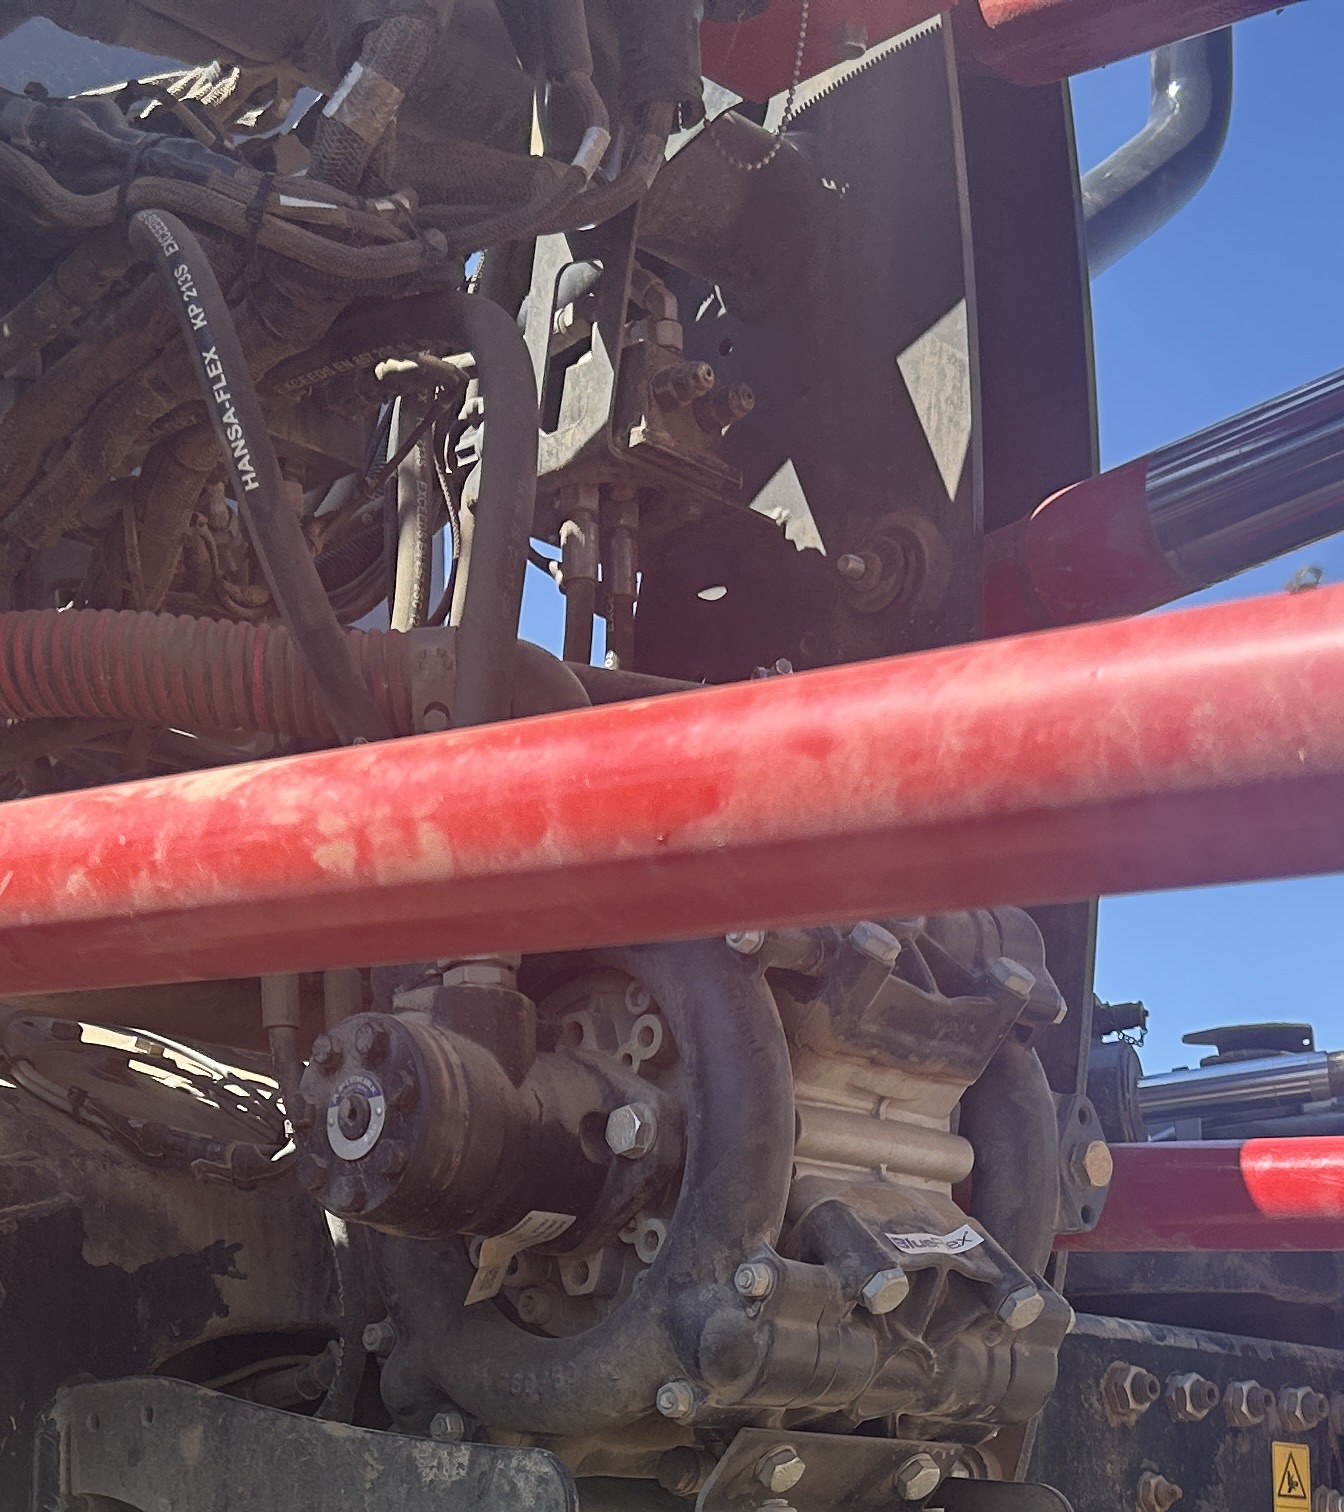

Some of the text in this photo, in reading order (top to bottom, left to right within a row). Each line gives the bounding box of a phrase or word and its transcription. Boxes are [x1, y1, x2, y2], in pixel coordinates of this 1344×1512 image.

[173, 264, 199, 302] 213S
[187, 304, 208, 331] KP
[201, 347, 259, 491] HANSA-FLEX
[415, 480, 428, 538] EXCEEDS
